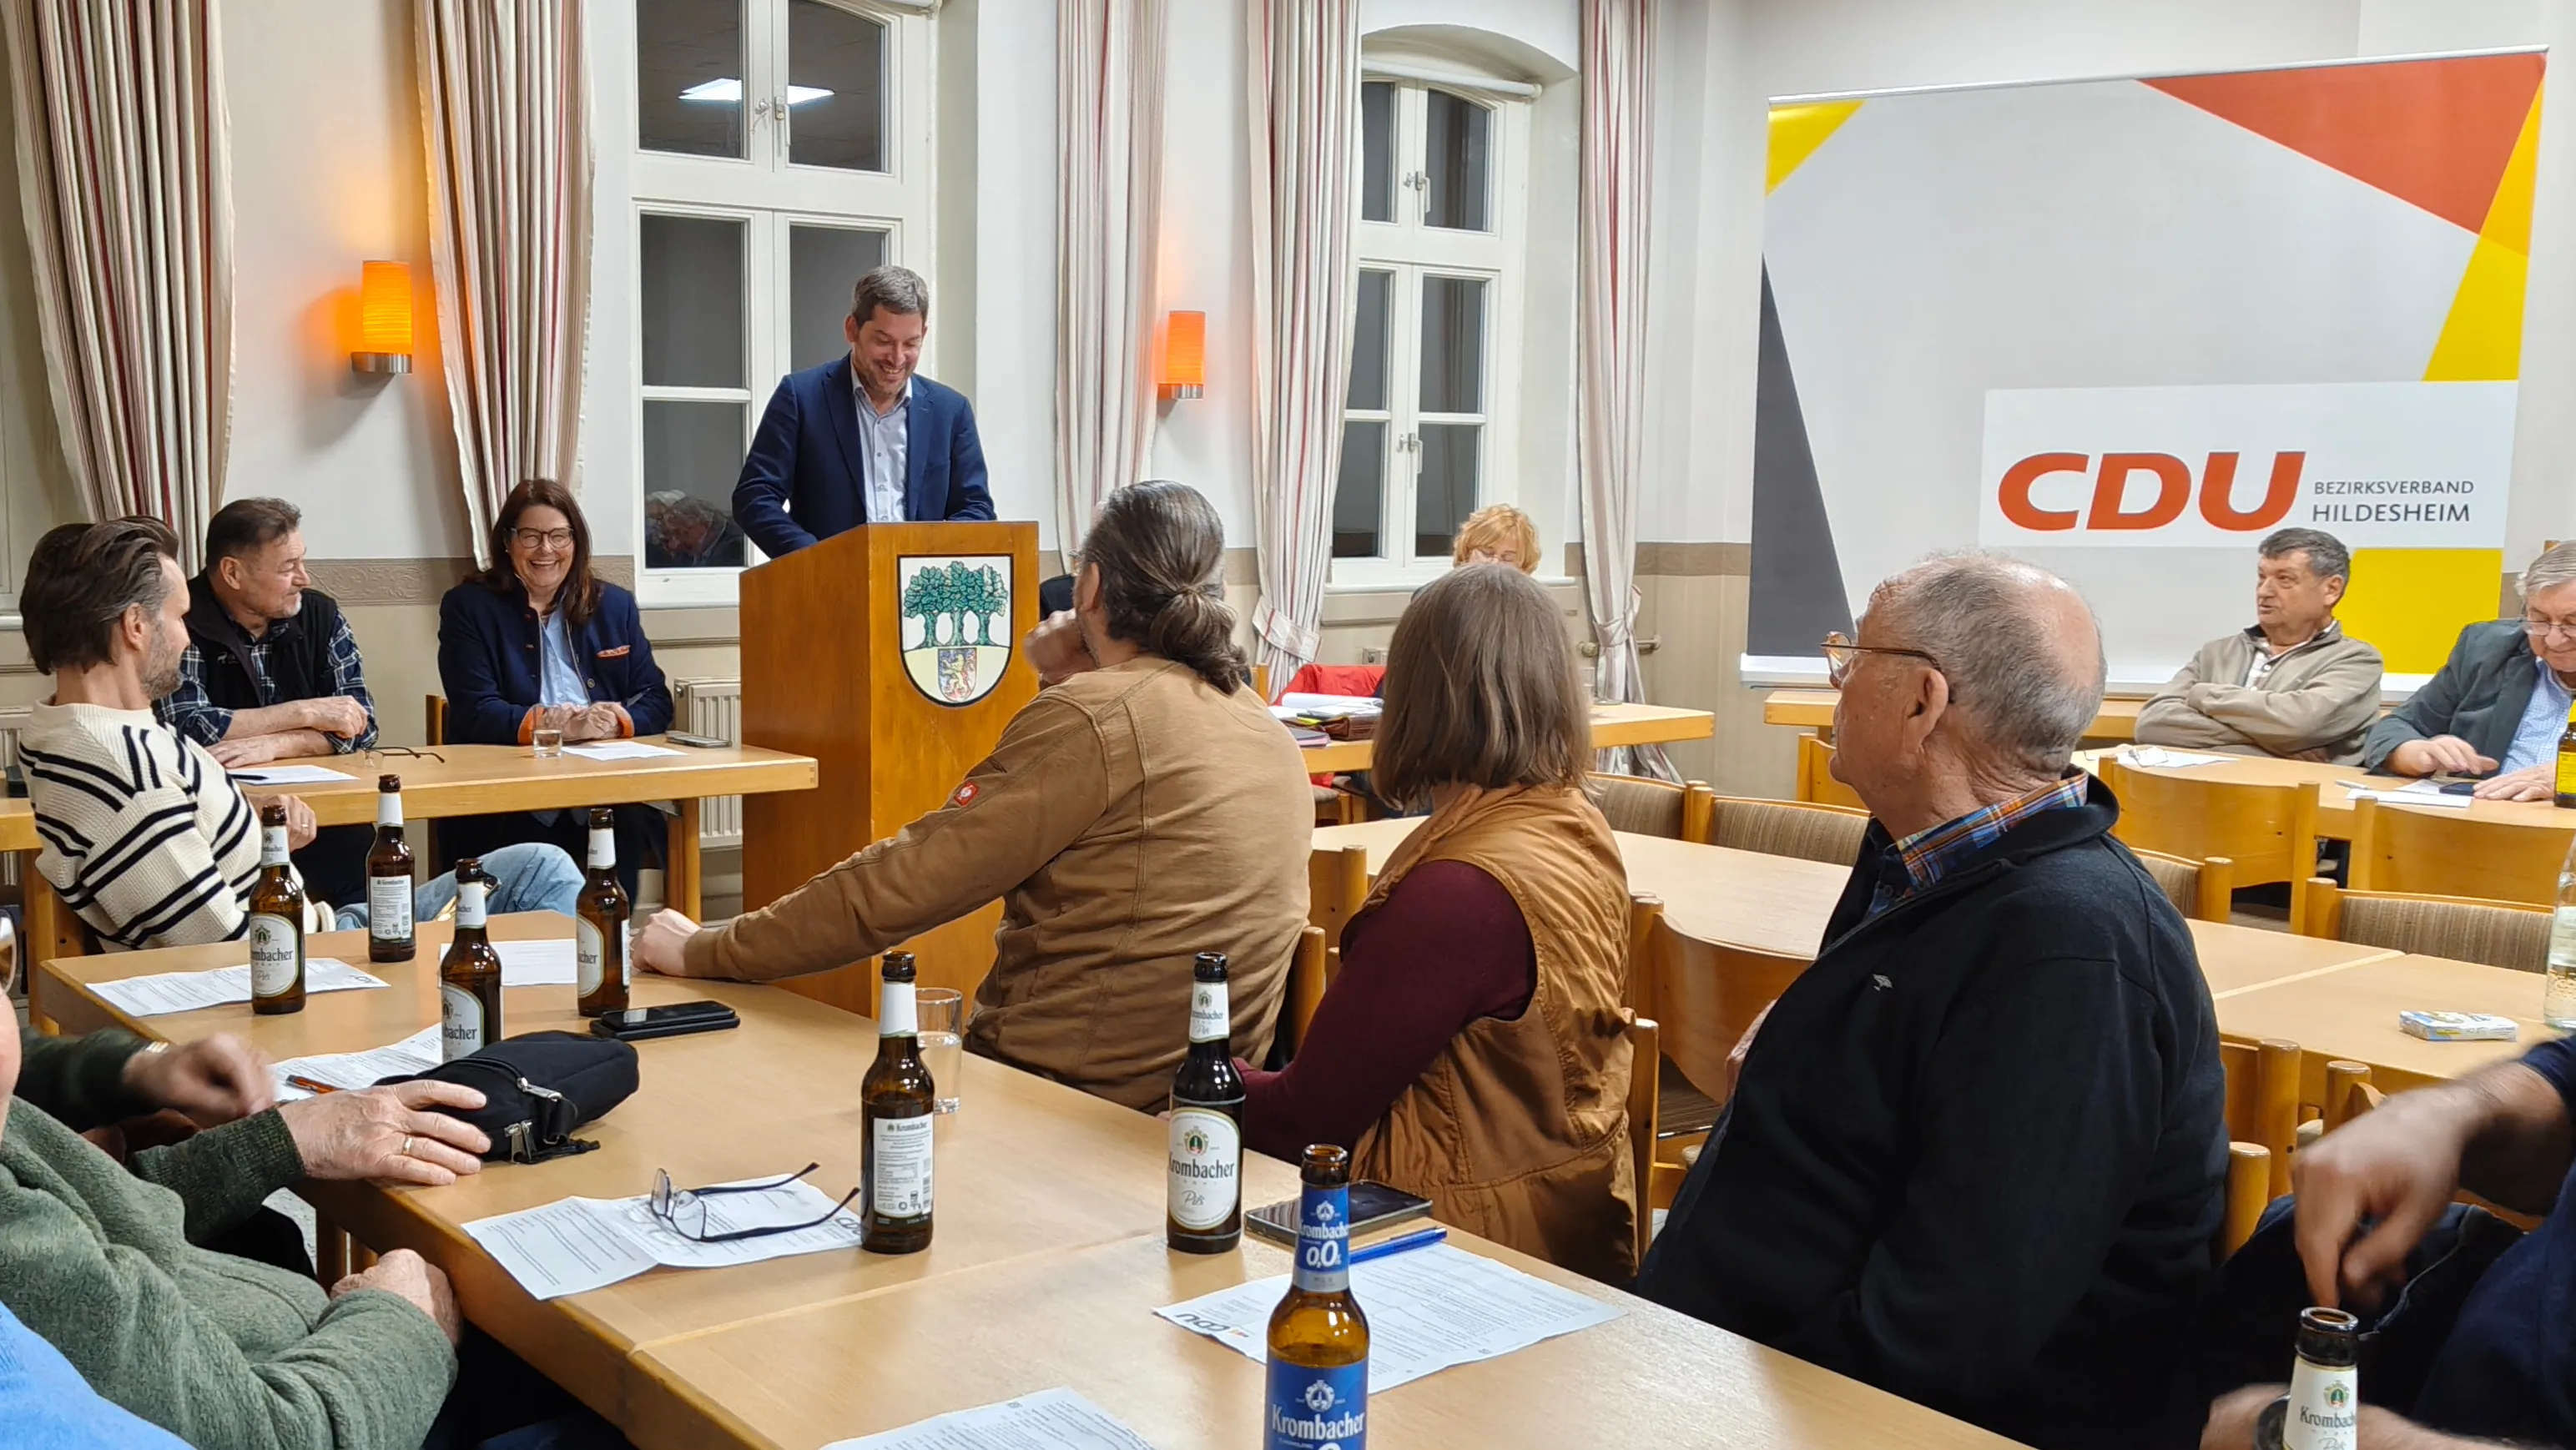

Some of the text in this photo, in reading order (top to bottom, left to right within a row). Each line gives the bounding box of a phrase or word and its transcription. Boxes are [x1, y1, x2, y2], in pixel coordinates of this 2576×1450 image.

[1998, 451, 2306, 531] CDU
[2314, 480, 2475, 496] BEZIRKSVERBAND
[2311, 502, 2471, 523] HILDESHEIM
[443, 1022, 478, 1040] bacher
[1272, 1403, 1365, 1441] Krombacher
